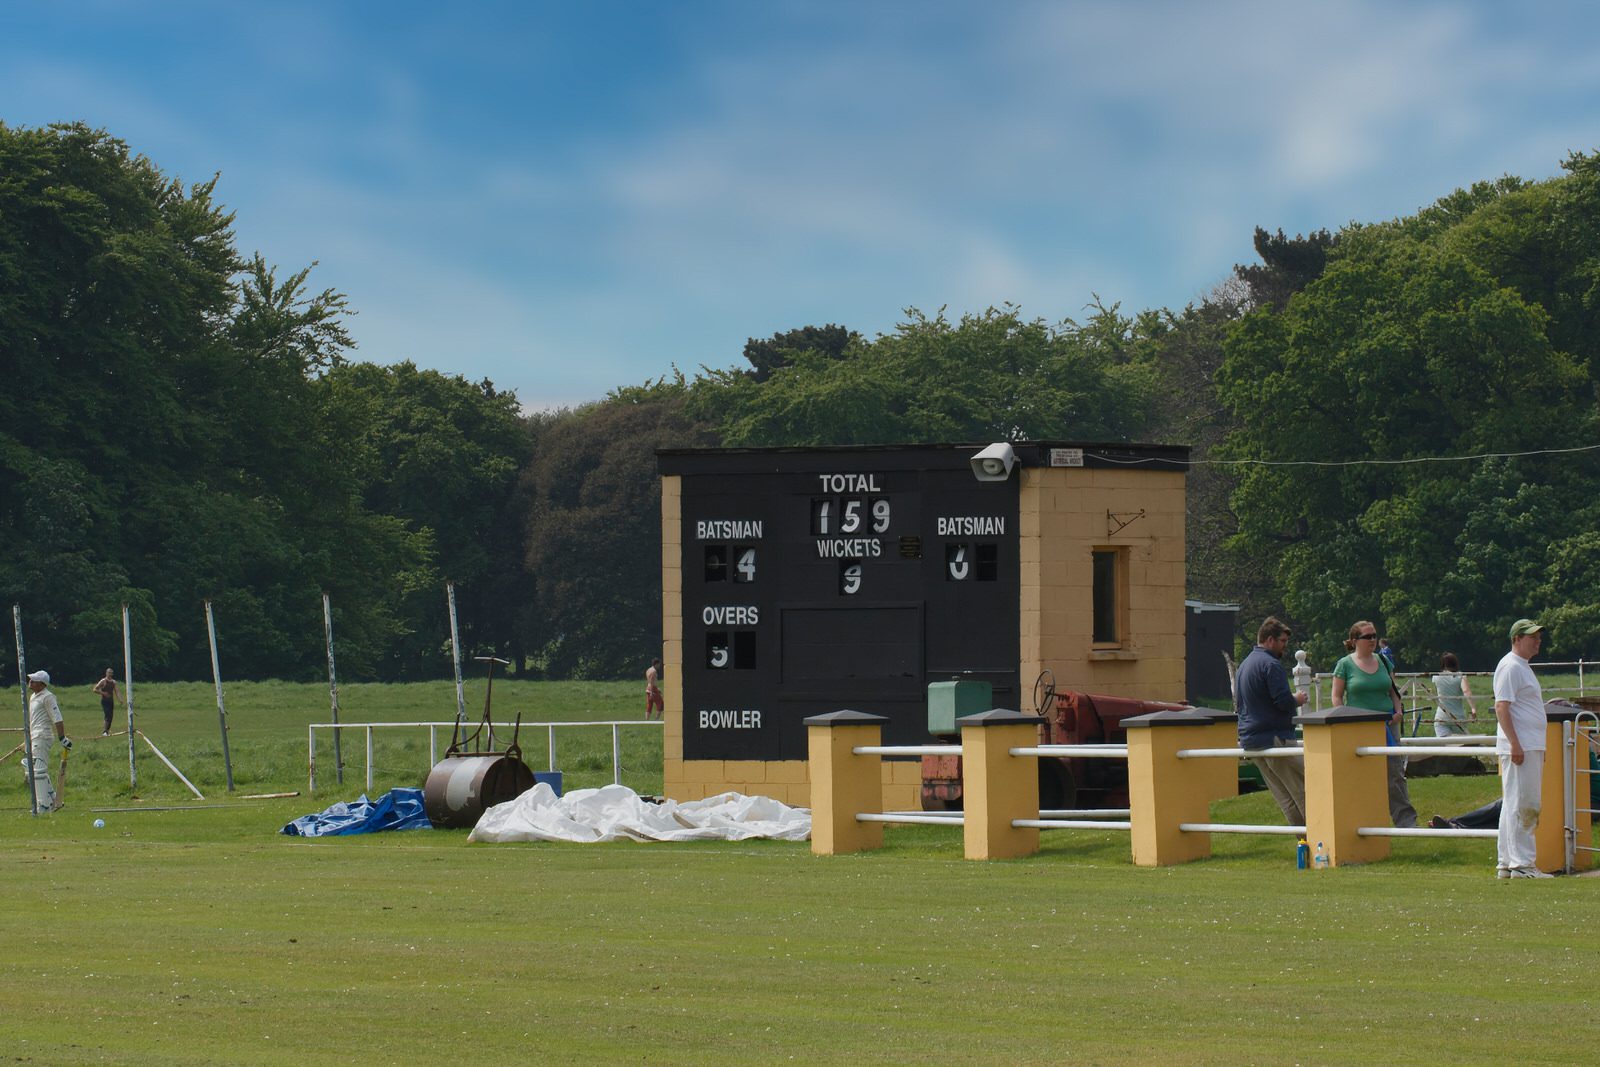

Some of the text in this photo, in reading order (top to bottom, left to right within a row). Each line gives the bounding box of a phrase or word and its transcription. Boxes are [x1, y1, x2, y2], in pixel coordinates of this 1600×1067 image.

[819, 474, 881, 493] TOTAL
[696, 520, 763, 539] BATSMAN
[937, 516, 1005, 536] BATSMAN
[816, 538, 881, 558] WICKETS
[702, 606, 759, 625] OVERS
[699, 710, 761, 729] BOWLER
